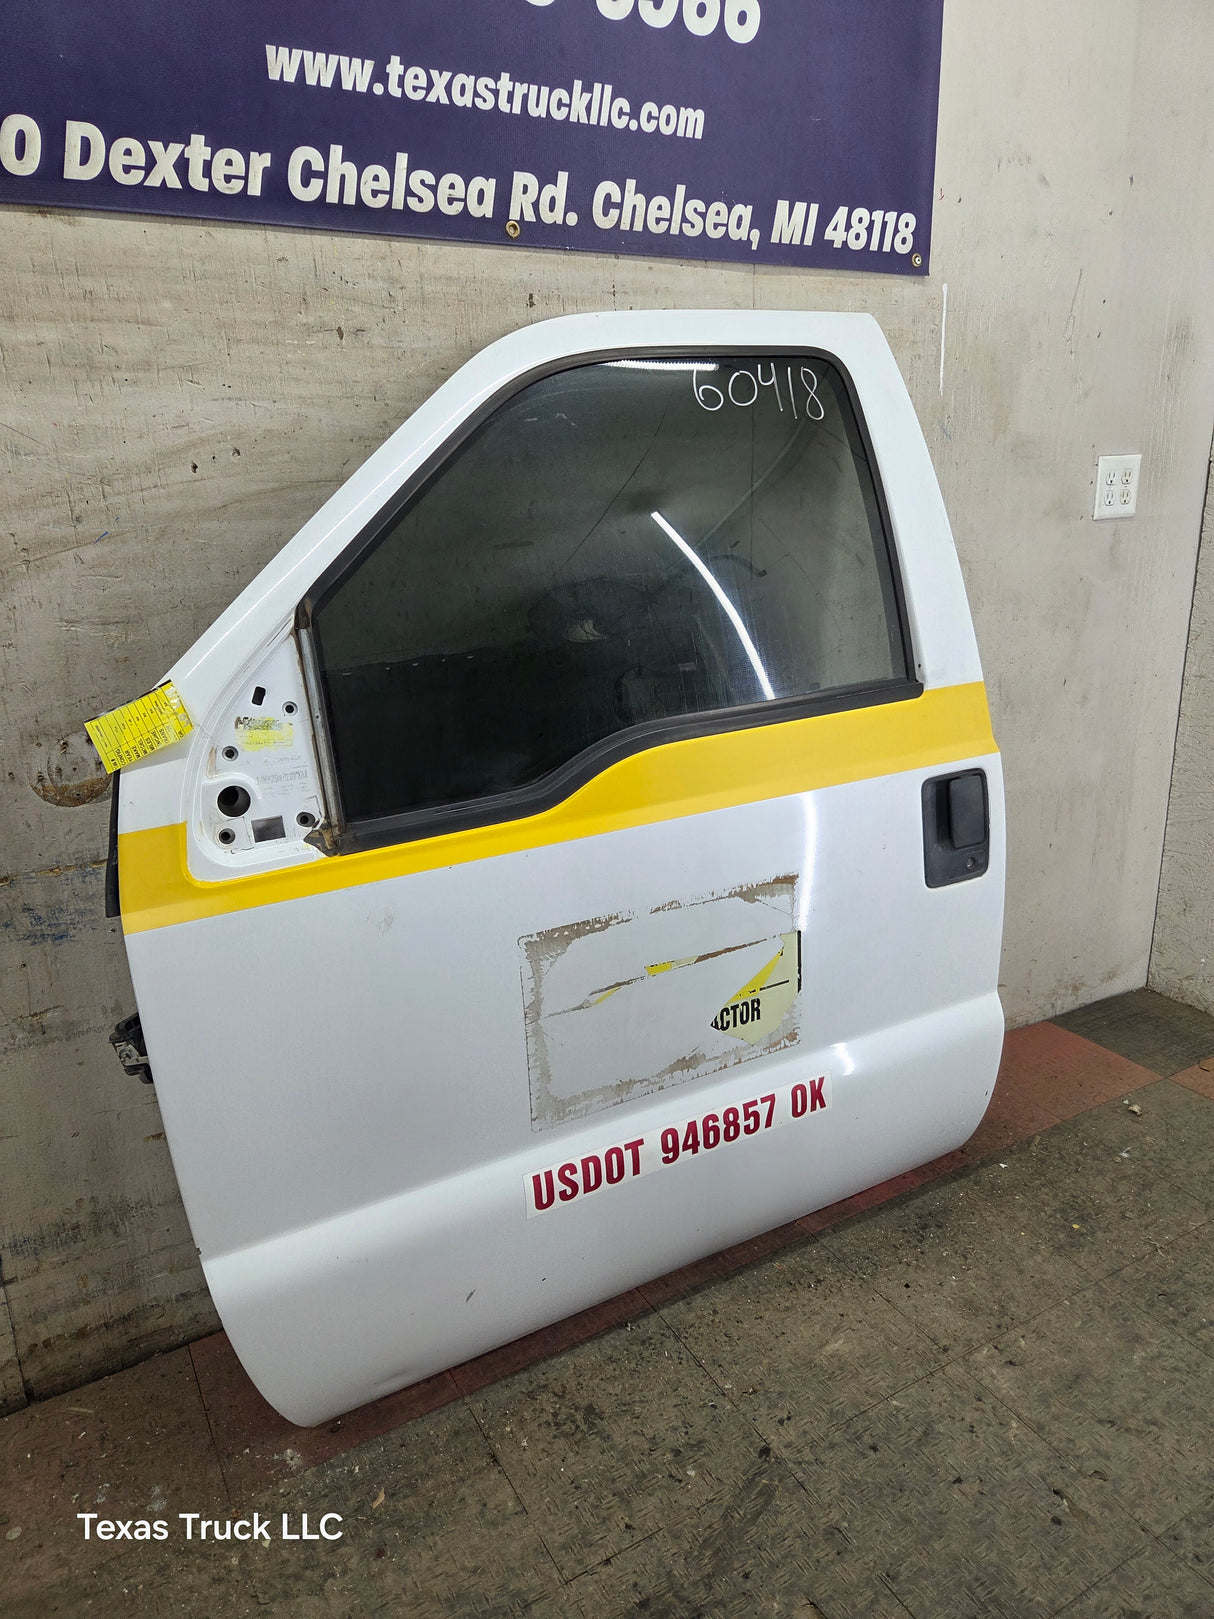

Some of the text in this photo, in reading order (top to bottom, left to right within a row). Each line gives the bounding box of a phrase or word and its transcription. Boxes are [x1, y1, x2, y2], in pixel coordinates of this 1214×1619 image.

[265, 44, 705, 139] www.texastruckllc.com
[63, 120, 271, 196] Dexter
[288, 144, 496, 218] Chelsea
[508, 171, 578, 227] Rd.
[592, 179, 760, 250] Chelsea,
[770, 200, 818, 246] MI
[824, 206, 917, 255] 48118
[693, 363, 825, 421] 60418
[532, 1076, 827, 1211] USDOT 946857 OK
